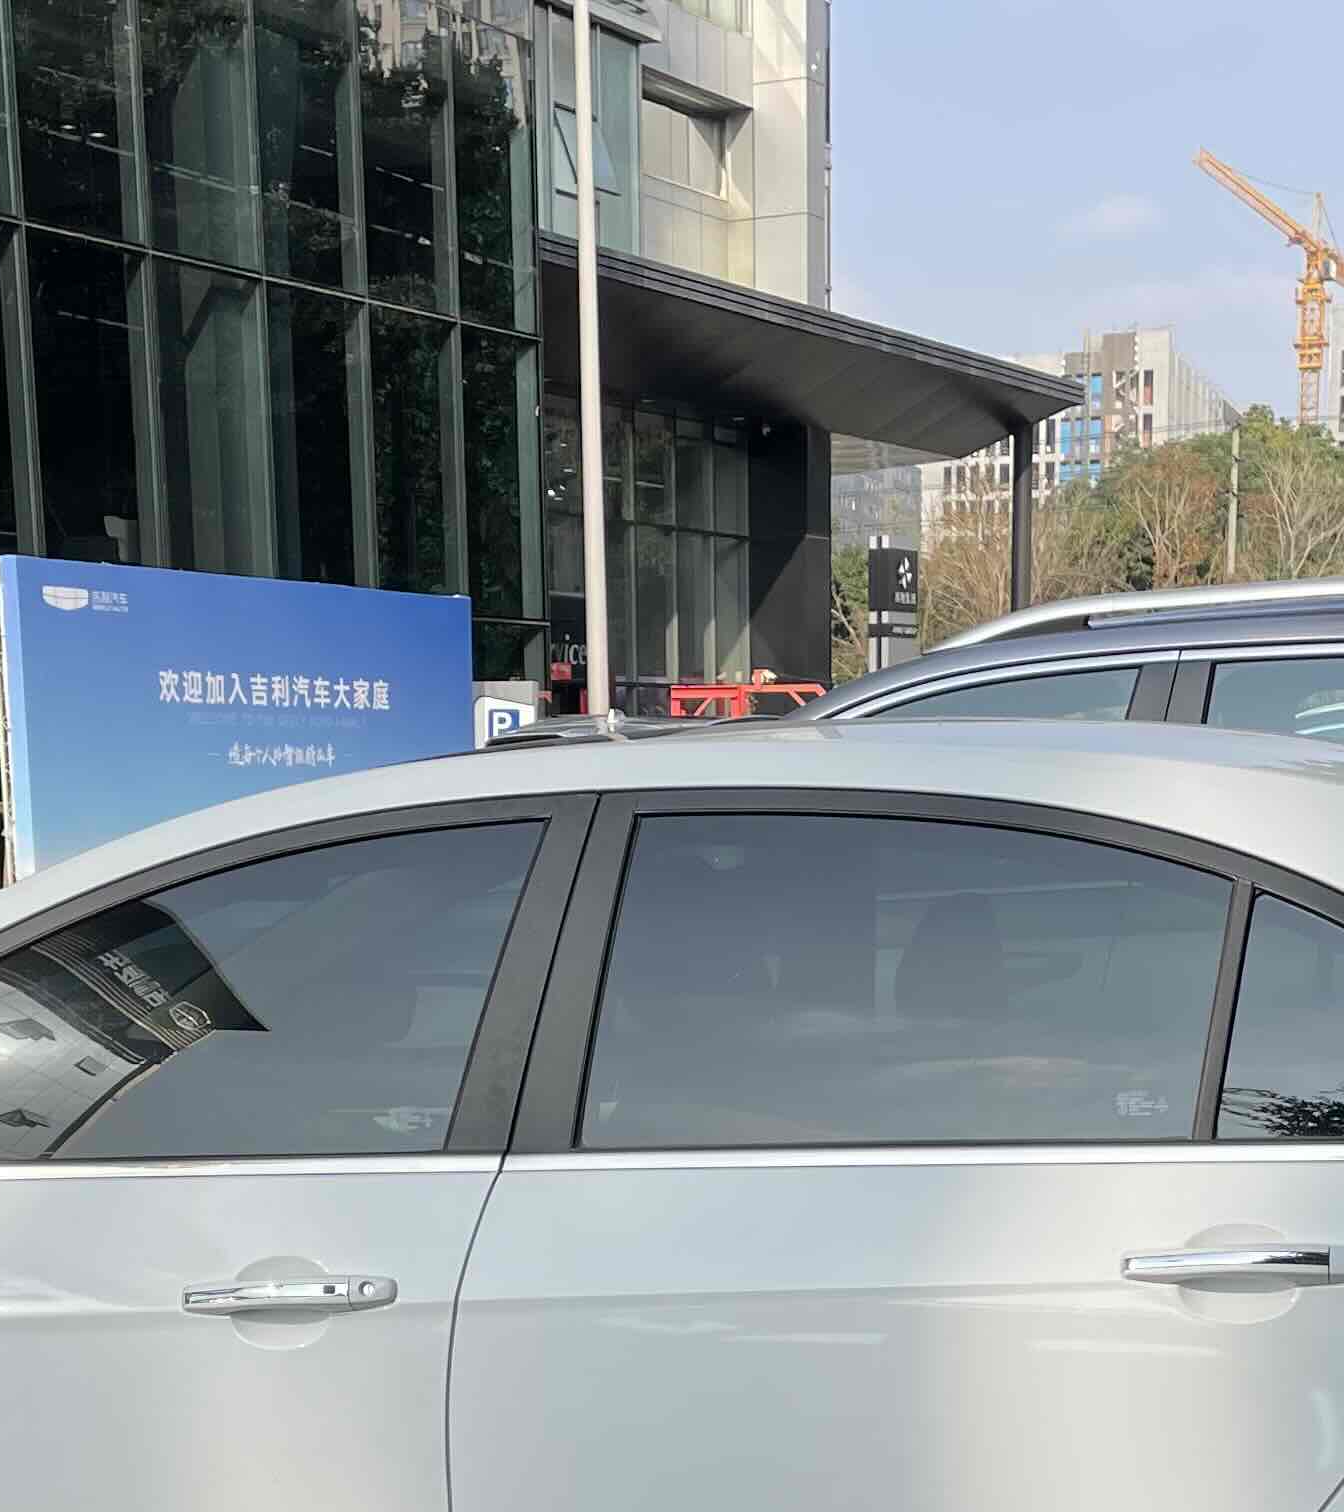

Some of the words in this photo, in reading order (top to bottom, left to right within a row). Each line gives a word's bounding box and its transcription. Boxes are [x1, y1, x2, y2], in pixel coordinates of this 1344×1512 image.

[159, 669, 391, 711] 欢迎加入吉利汽车大家庭
[492, 710, 513, 737] P
